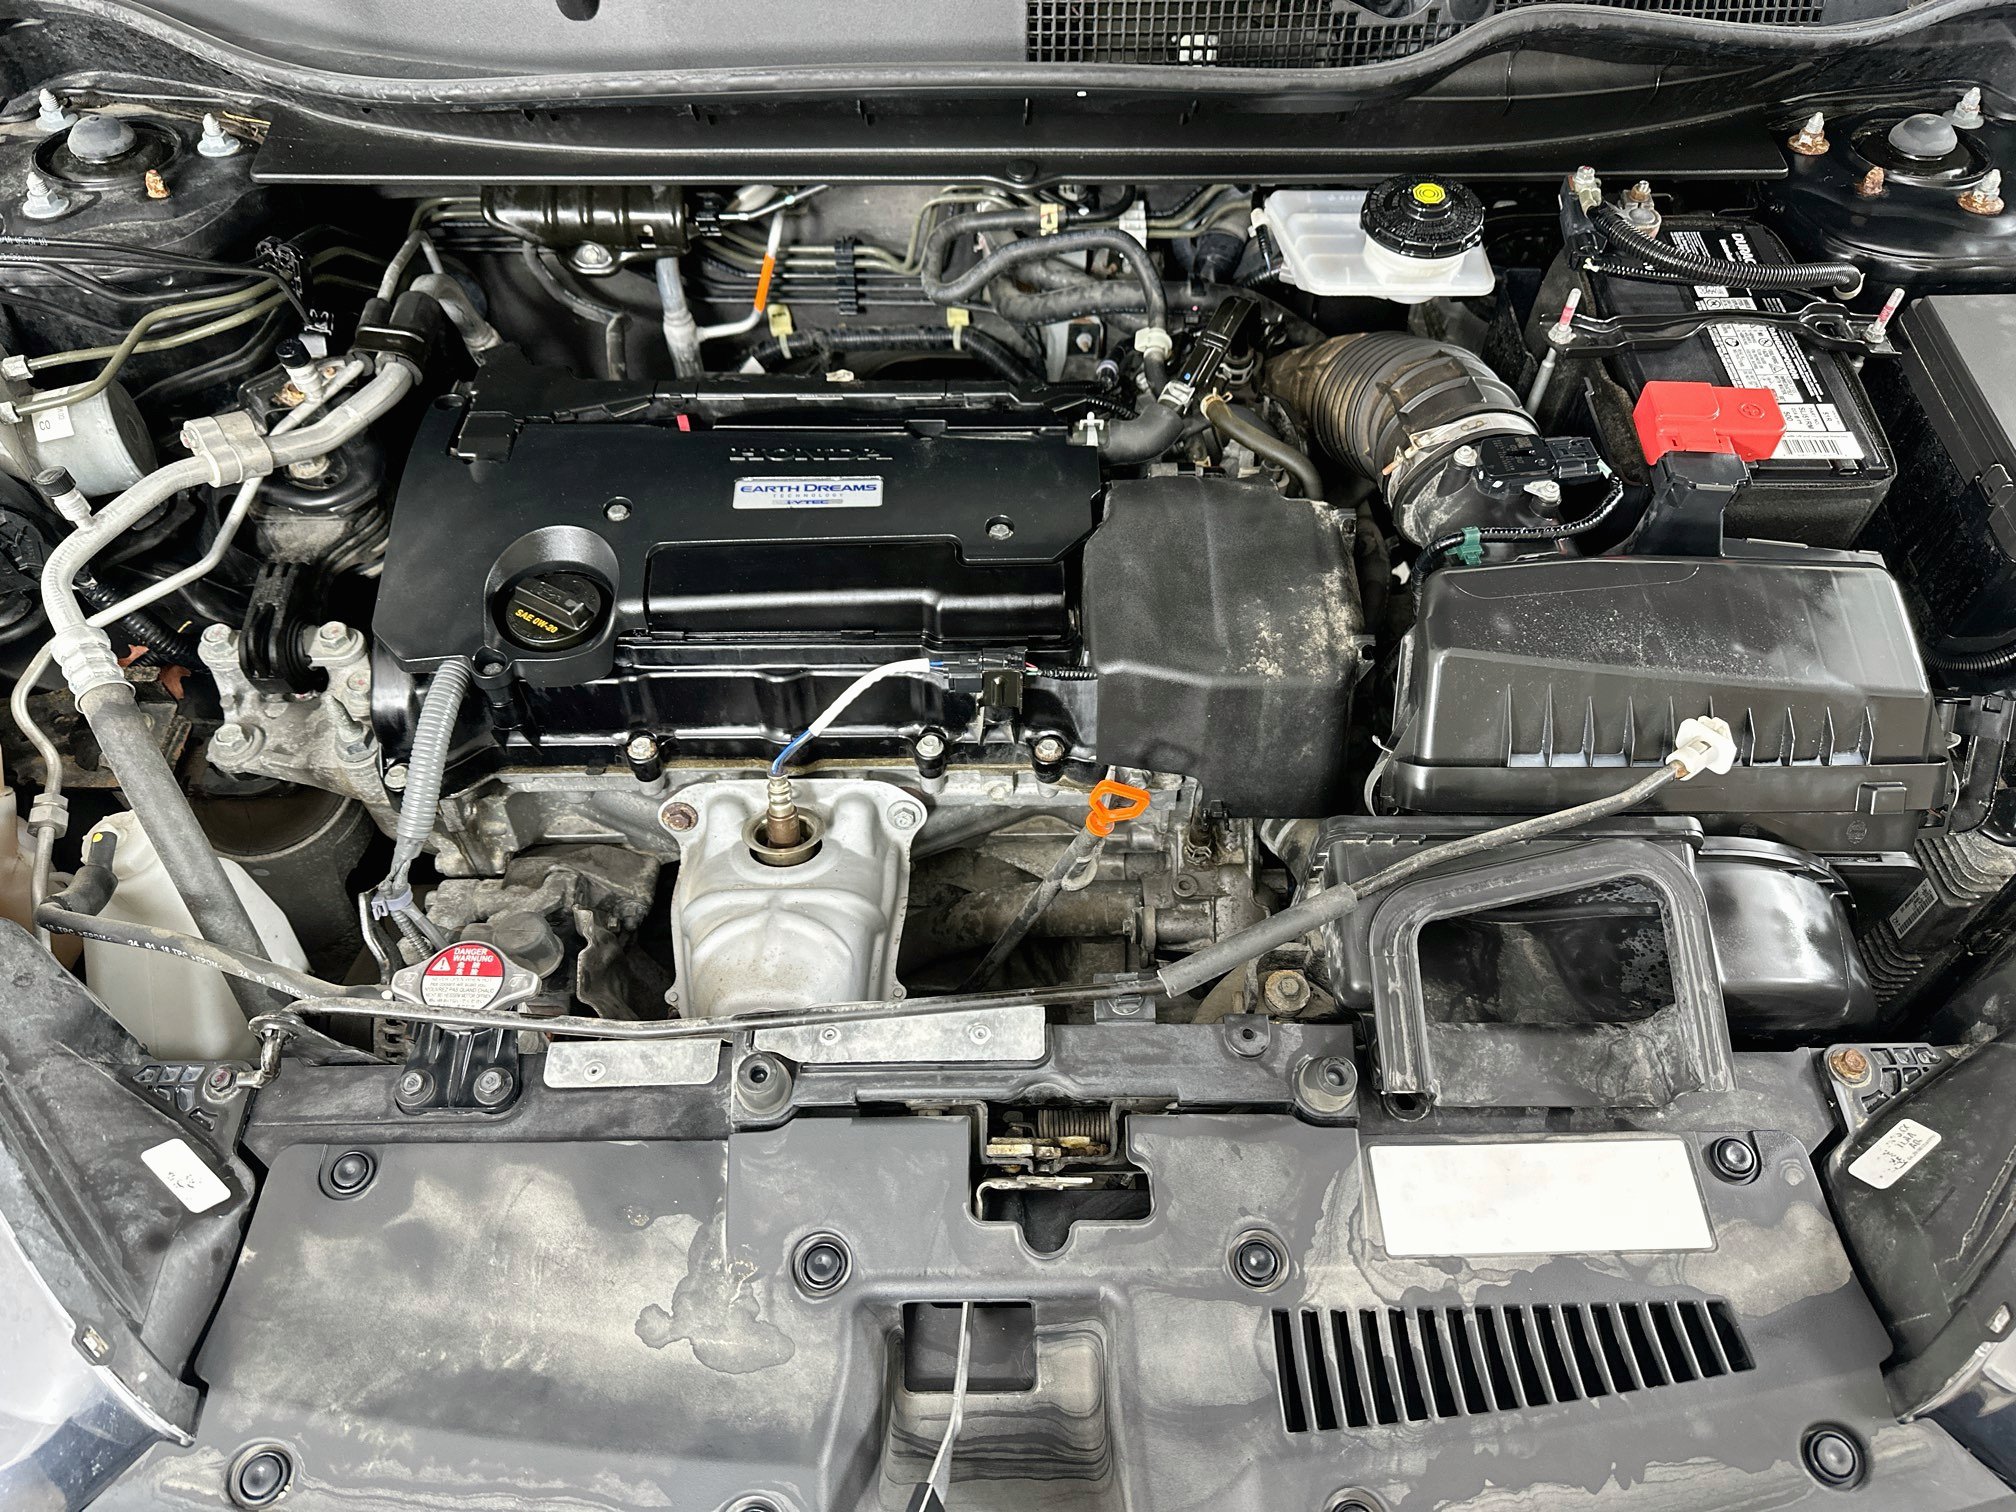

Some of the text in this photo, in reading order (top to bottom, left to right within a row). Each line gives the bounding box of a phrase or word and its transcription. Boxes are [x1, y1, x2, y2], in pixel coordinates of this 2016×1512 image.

[1731, 233, 1757, 265] DURAC
[729, 448, 893, 461] HONDA
[740, 484, 878, 493] EARTH DREAMS
[515, 609, 559, 634] SAE 0W-20
